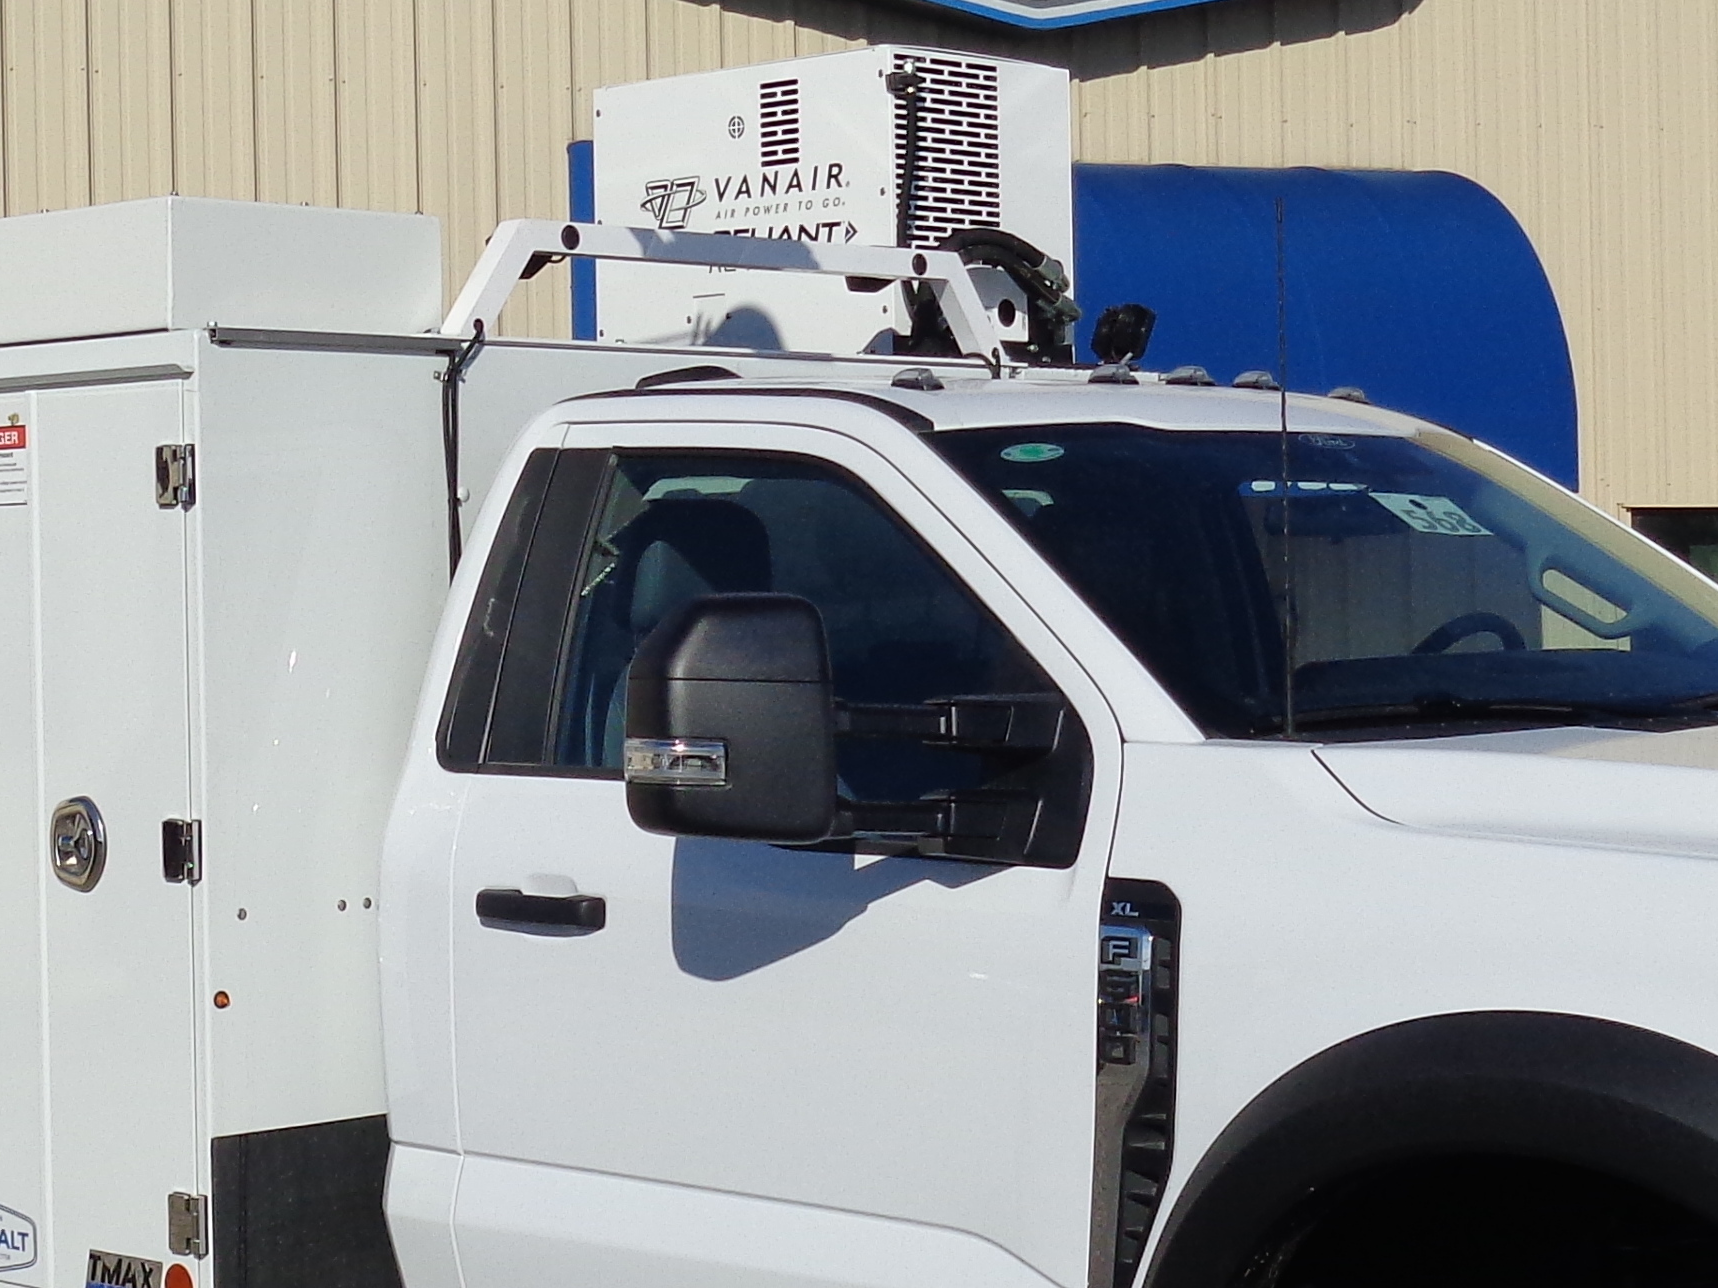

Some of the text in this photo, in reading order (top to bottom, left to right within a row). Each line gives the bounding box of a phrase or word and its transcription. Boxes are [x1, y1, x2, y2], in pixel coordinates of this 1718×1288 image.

[714, 162, 844, 203] VANAIR
[715, 208, 736, 220] AIR
[744, 202, 789, 217] POWER
[798, 199, 814, 211] TO
[713, 220, 842, 244] IANT
[1401, 509, 1482, 534] 568
[1111, 902, 1139, 918] XL
